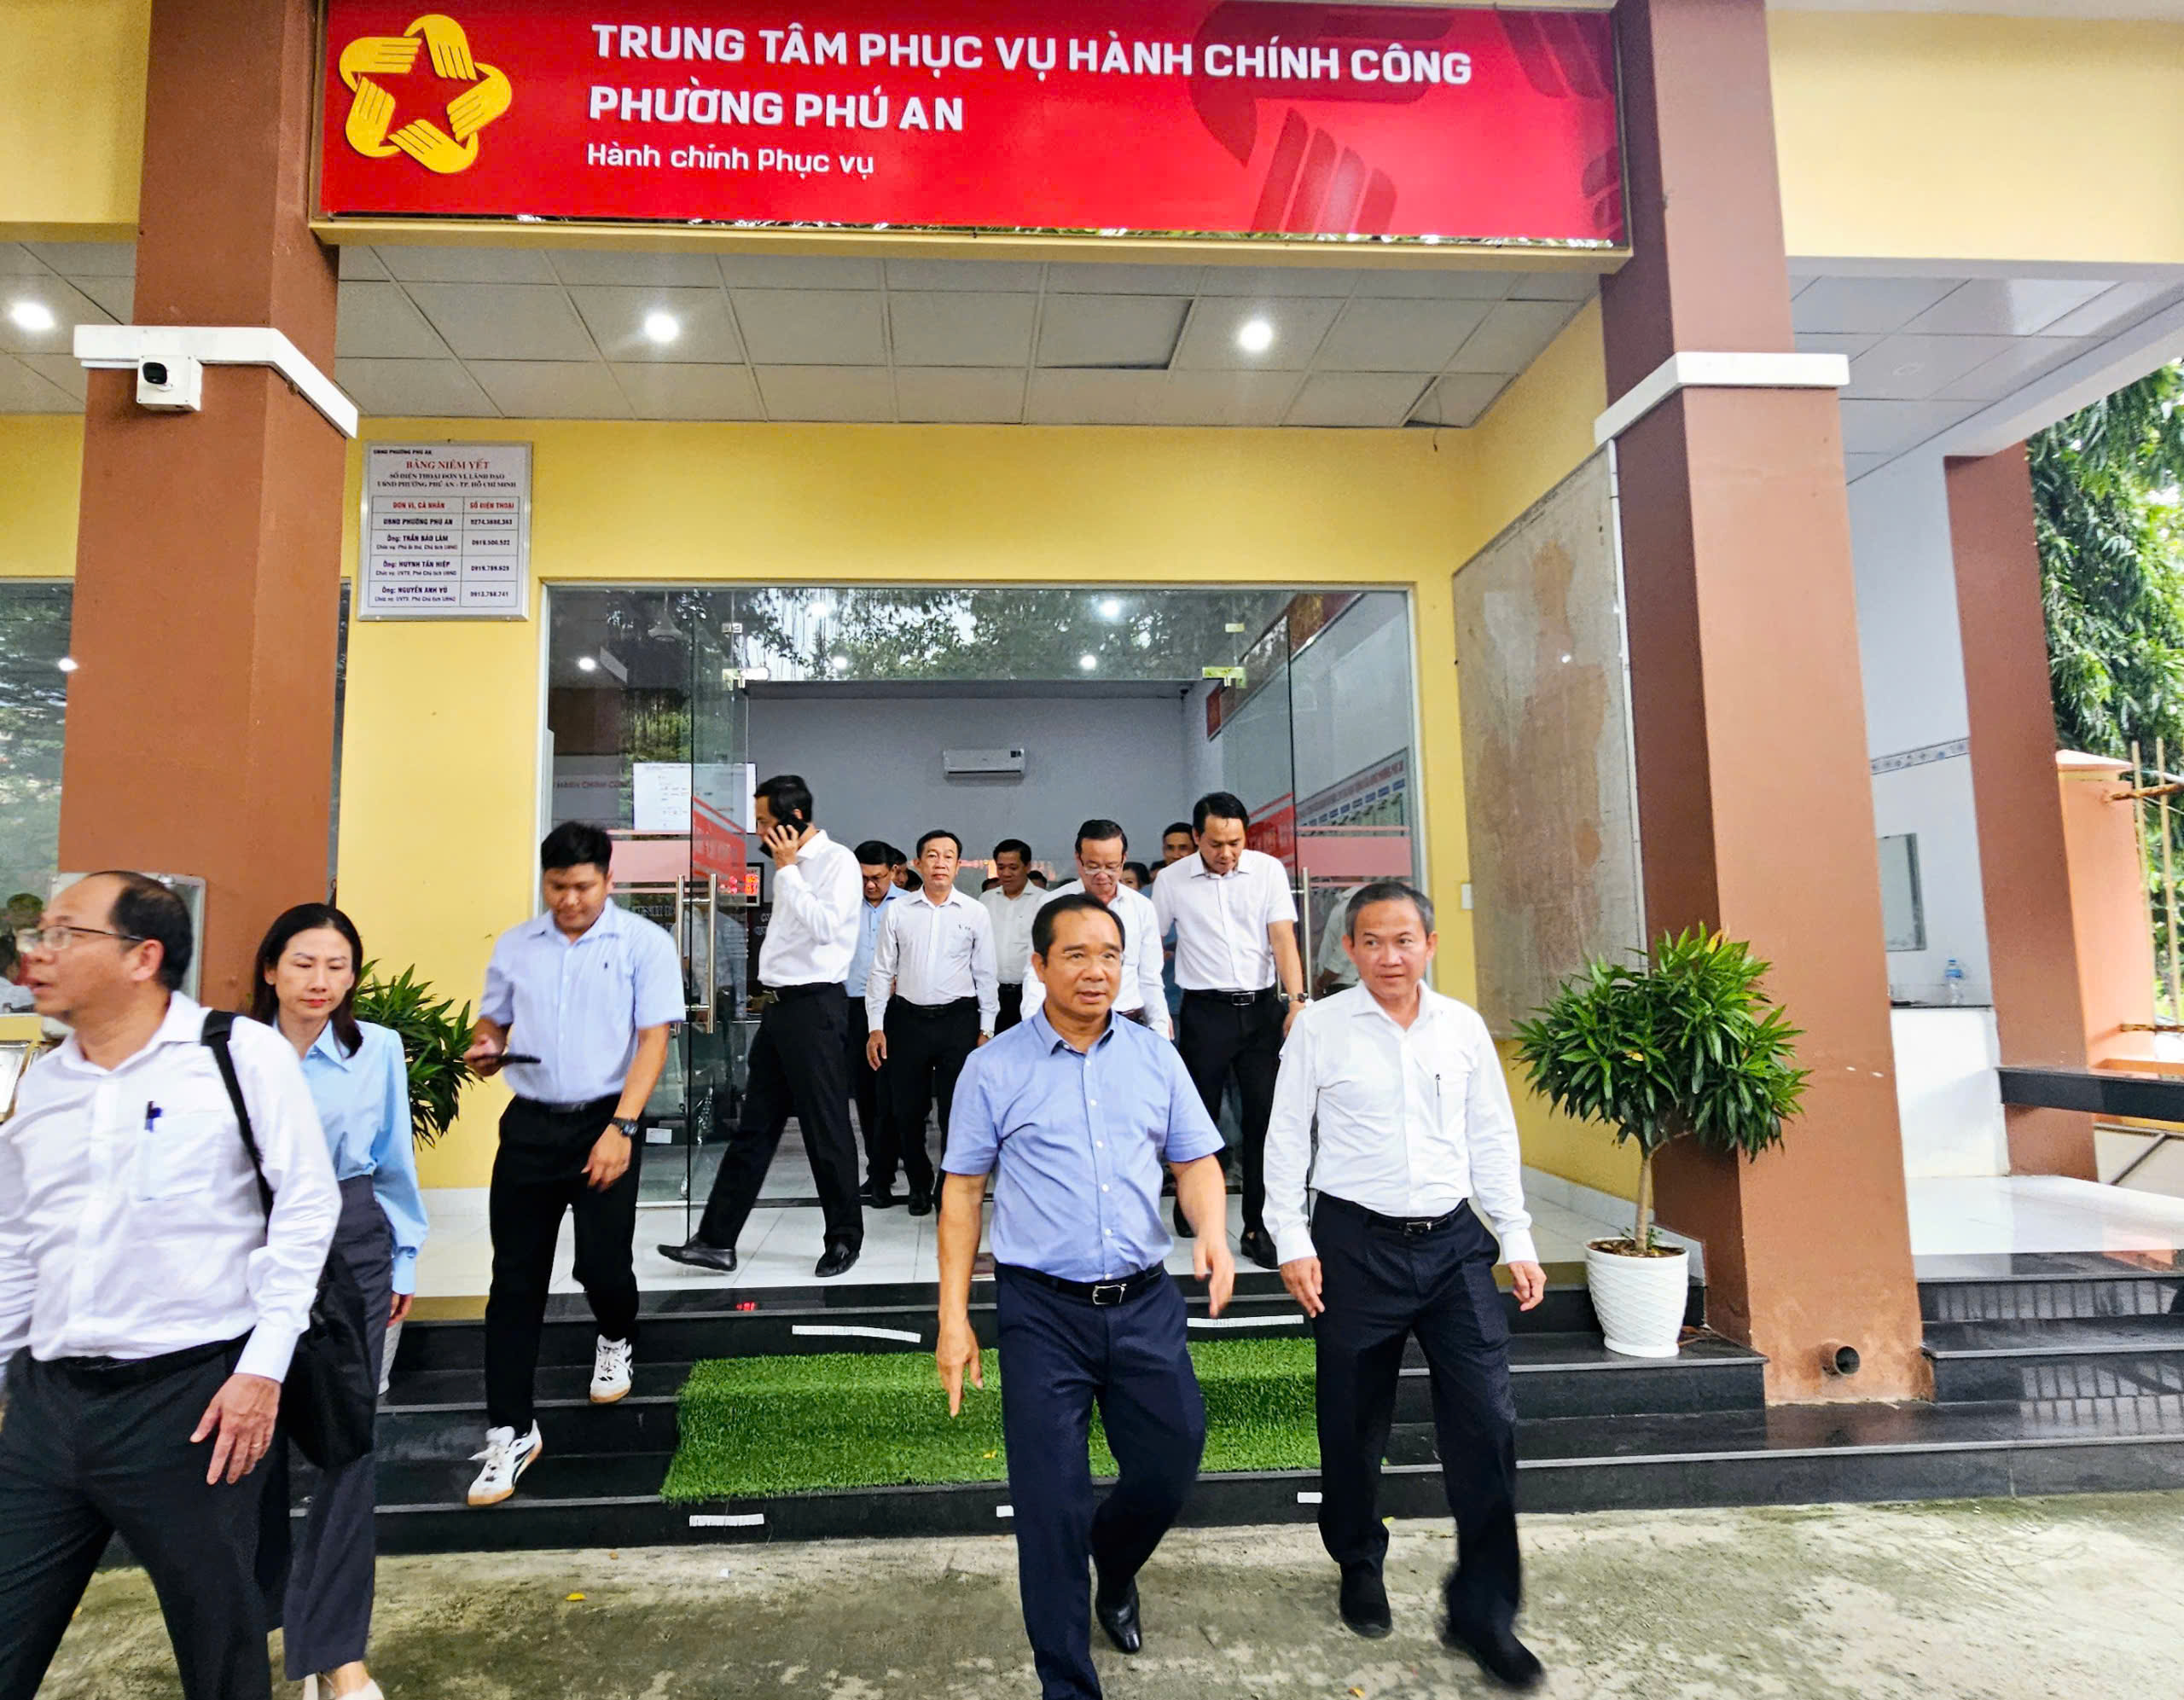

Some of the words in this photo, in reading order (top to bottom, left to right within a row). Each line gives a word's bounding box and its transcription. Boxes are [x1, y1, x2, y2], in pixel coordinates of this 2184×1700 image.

[591, 24, 745, 62] TRUNG
[758, 22, 848, 65] TÂM
[859, 32, 983, 78] PHỤC
[994, 37, 1056, 81] VỤ
[1068, 31, 1193, 76] HÀNH
[1204, 36, 1339, 80] CHÍNH
[1350, 43, 1472, 84] CÔNG
[588, 77, 784, 127] PHƯỜNG
[794, 84, 889, 129] PHÚ
[897, 96, 964, 131] AN
[587, 141, 661, 168] Hành
[671, 144, 750, 171] chính
[758, 148, 830, 178] Phục
[839, 156, 874, 181] vụ
